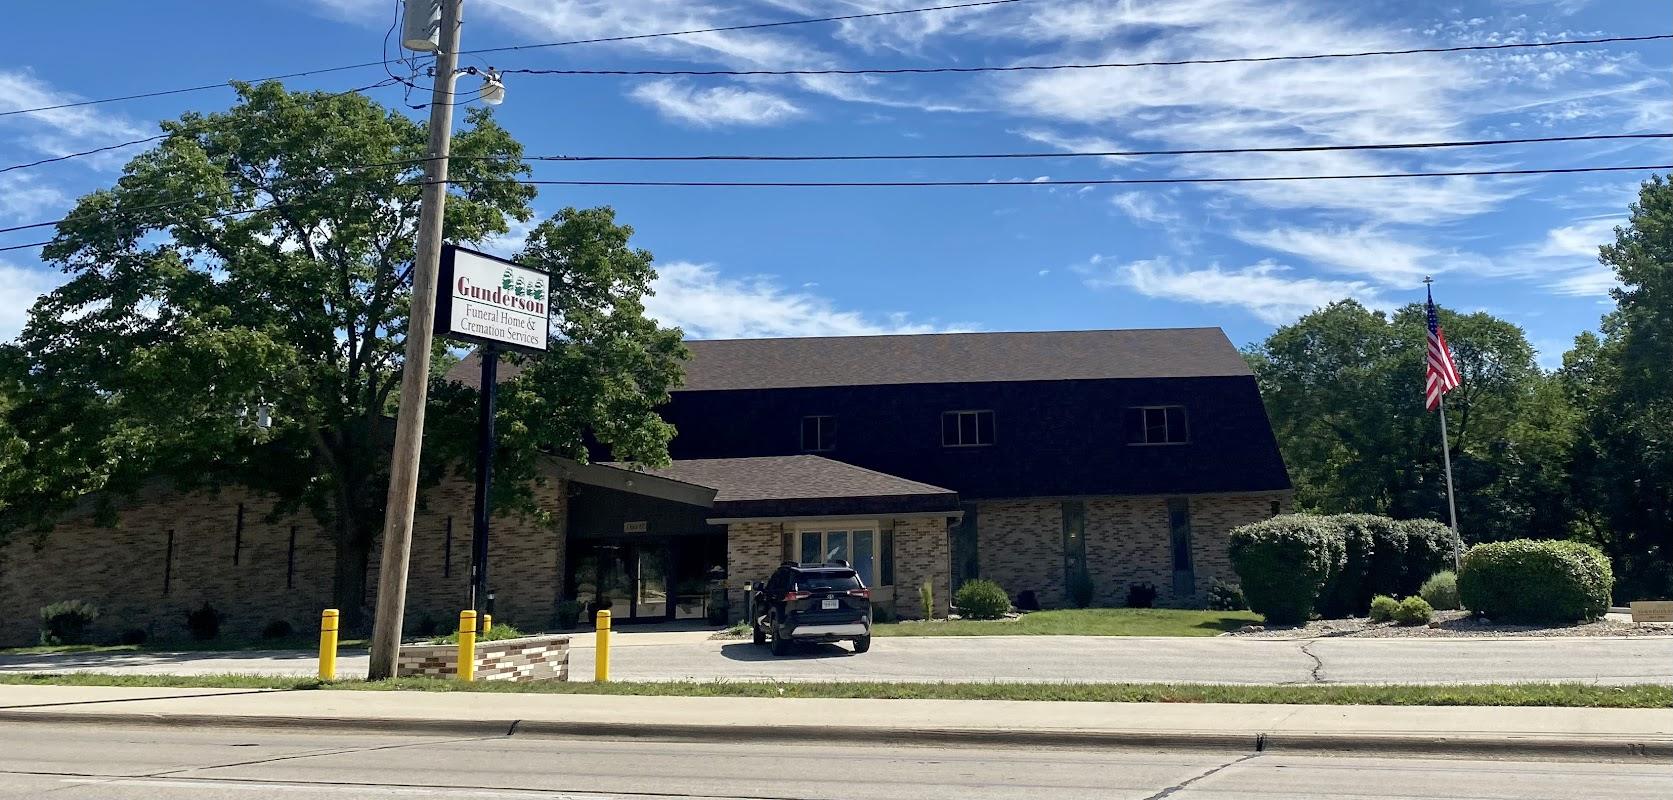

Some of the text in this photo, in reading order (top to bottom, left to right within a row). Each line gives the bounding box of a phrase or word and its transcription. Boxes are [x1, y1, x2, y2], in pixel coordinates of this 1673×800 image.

[457, 276, 544, 314] Gunderson
[460, 317, 539, 345] Cremation Services
[466, 303, 536, 331] Funeral Home &
